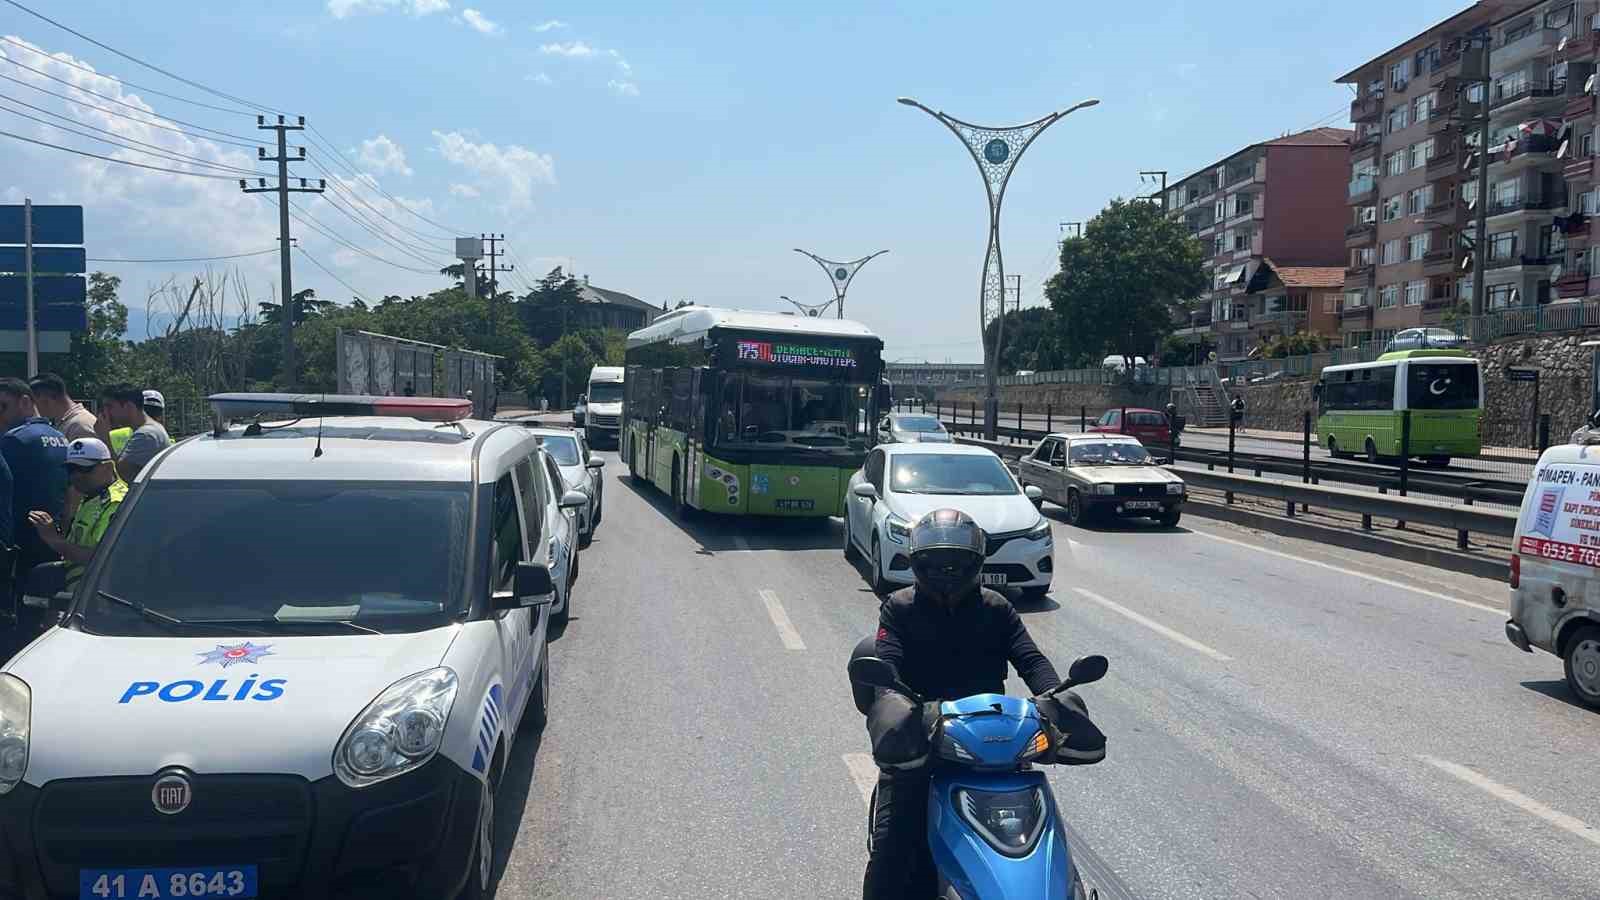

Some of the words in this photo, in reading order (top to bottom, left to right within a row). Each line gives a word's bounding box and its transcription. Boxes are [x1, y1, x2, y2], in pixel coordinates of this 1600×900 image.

[1542, 542, 1575, 561] 0532
[118, 673, 288, 704] POLİS
[160, 787, 183, 805] FIAT
[92, 874, 126, 898] 41
[138, 874, 160, 898] A
[169, 870, 245, 897] 8643
